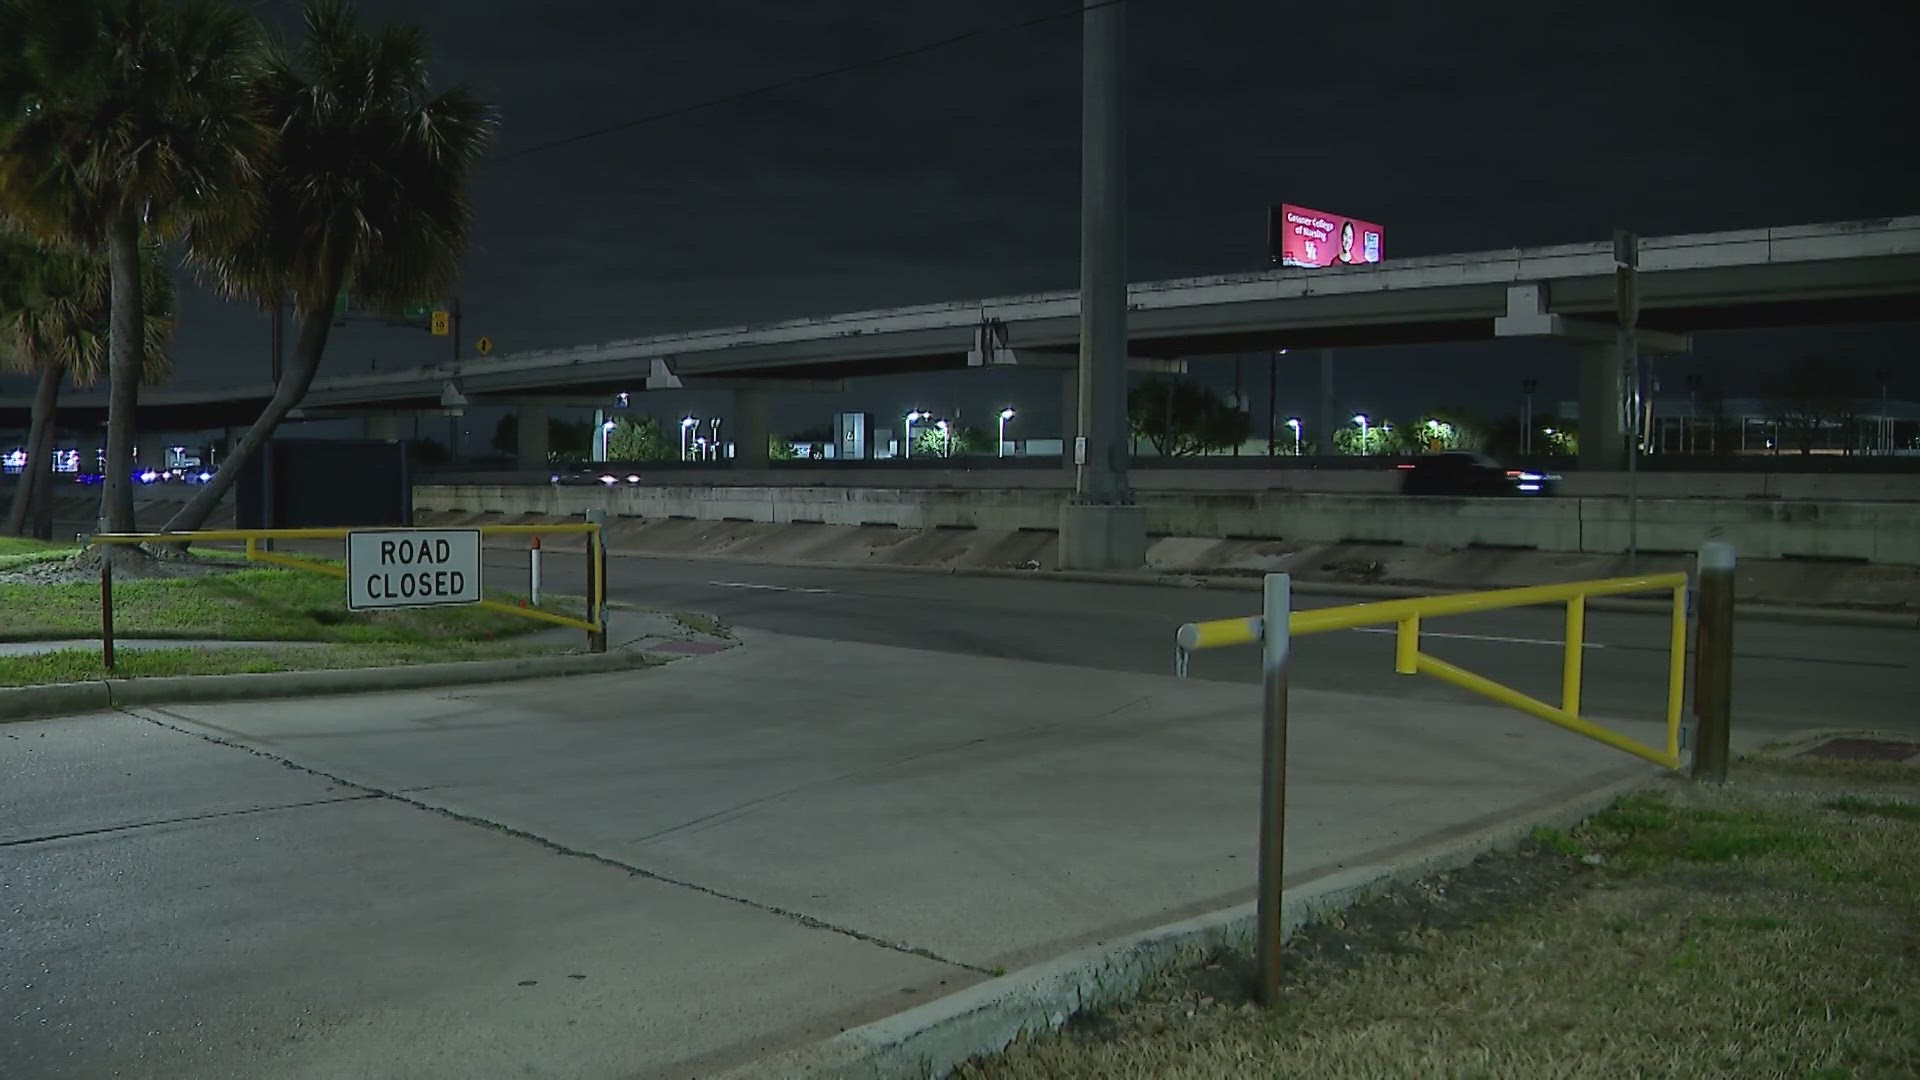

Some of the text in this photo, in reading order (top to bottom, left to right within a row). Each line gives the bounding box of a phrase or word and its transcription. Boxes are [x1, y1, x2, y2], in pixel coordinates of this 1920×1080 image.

[1295, 226, 1303, 235] of
[1312, 218, 1335, 232] College
[381, 539, 450, 565] ROAD
[367, 571, 464, 598] CLOSED
